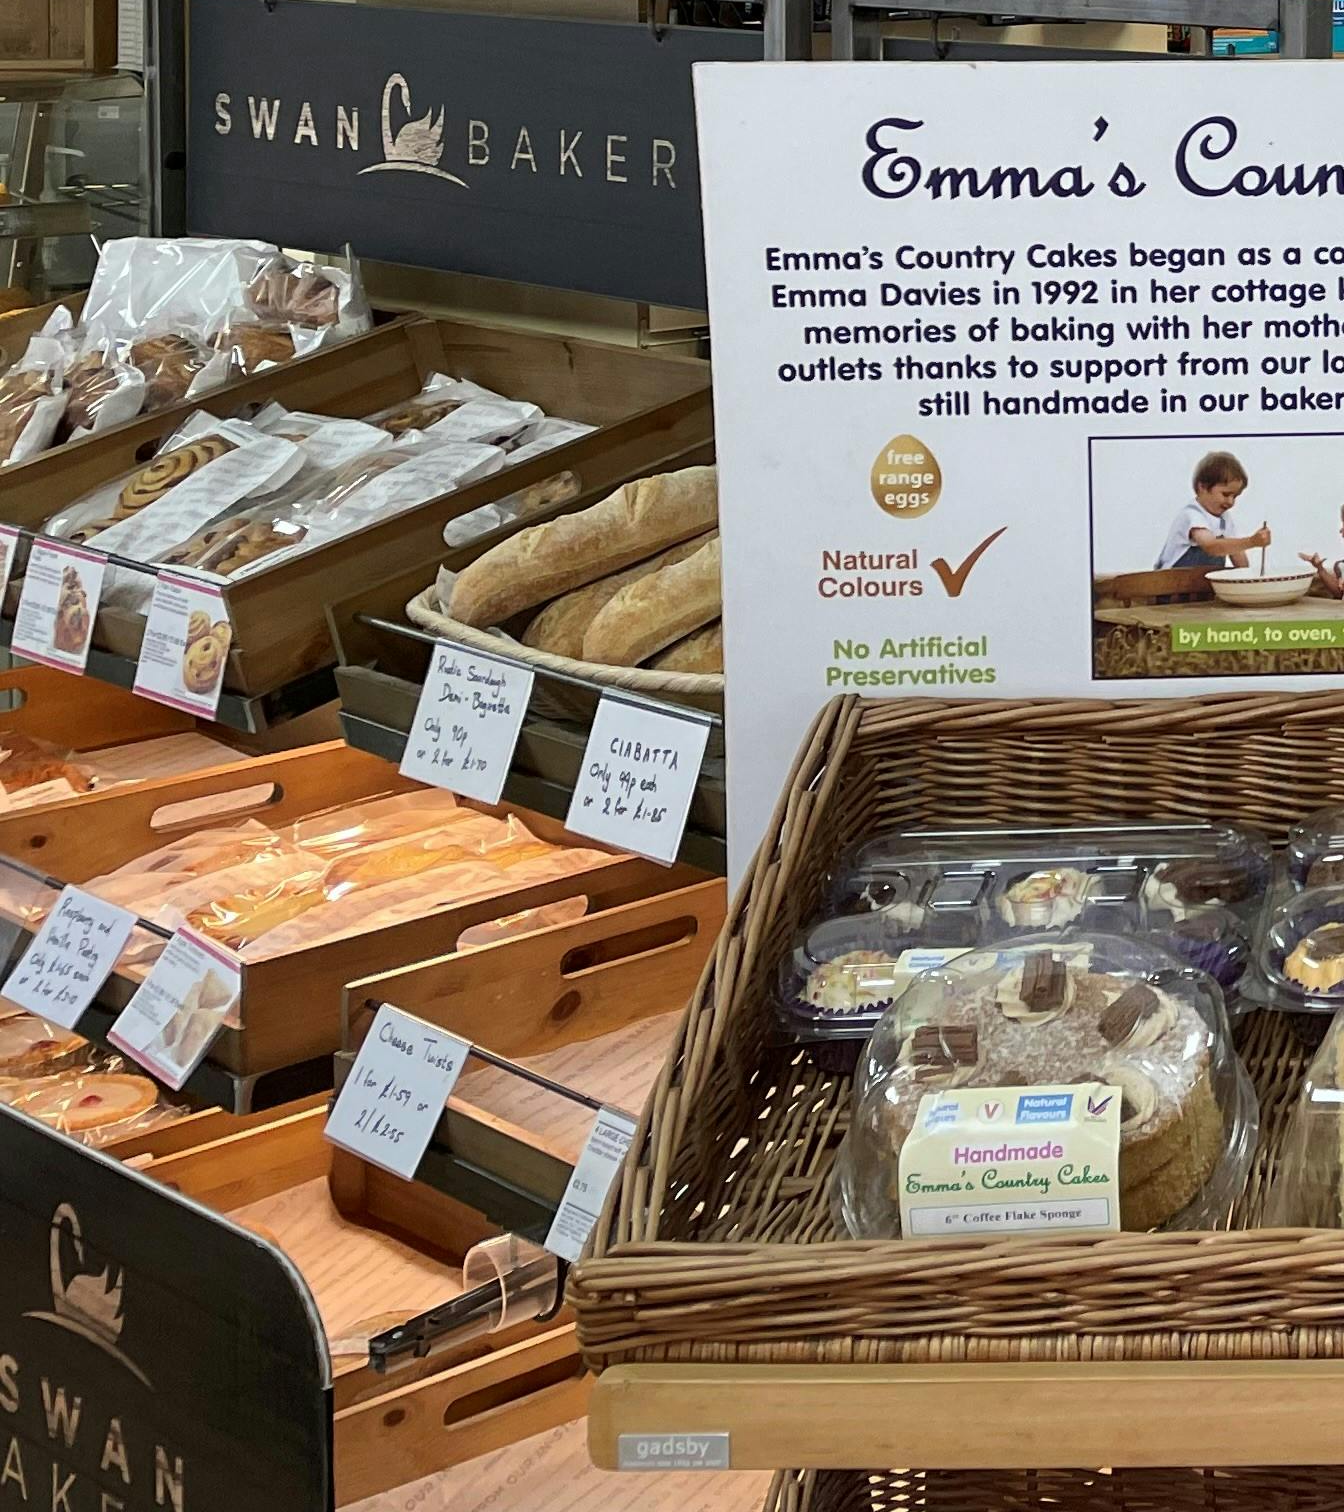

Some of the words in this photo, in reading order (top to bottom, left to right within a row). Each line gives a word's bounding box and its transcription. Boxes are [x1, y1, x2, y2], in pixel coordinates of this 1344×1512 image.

[214, 92, 360, 152] SWAN
[468, 119, 678, 190] BAKER
[861, 115, 1147, 200] Emma's
[765, 245, 884, 272] Emma's
[895, 244, 1016, 275] Country
[1026, 243, 1118, 269] Cakes
[1128, 242, 1226, 274] began
[1237, 247, 1272, 267] as
[1282, 245, 1302, 266] a
[770, 284, 867, 308] Emma
[880, 281, 982, 307] Davies
[992, 280, 1020, 305] in
[1031, 280, 1099, 305] 1992
[1110, 279, 1138, 305] in
[1149, 279, 1202, 304] her
[1211, 277, 1327, 308] cottage
[803, 318, 957, 345] memories
[967, 316, 1000, 343] of
[1010, 316, 1115, 347] baking
[1126, 314, 1191, 341] with
[1202, 314, 1253, 340] her
[777, 355, 884, 383] outlets
[893, 354, 997, 381] thanks
[1008, 354, 1039, 380] to
[1049, 353, 1167, 384] support
[1176, 350, 1249, 377] from
[1260, 355, 1312, 376] our
[918, 390, 970, 417] still
[982, 389, 1149, 416] handmade
[1160, 388, 1188, 413] in
[1198, 392, 1250, 413] our
[886, 448, 925, 467] free
[878, 469, 935, 490] range
[883, 491, 930, 509] eggs
[821, 548, 919, 571] Natural
[817, 575, 924, 599] Colours
[832, 639, 871, 660] No
[878, 635, 988, 659] Artificial
[1178, 627, 1202, 648] by
[1206, 626, 1259, 647] hand,
[1264, 625, 1283, 642] to
[1288, 626, 1336, 644] oven,
[825, 663, 997, 687] Preservatives
[609, 737, 680, 771] CIABATTA
[378, 1021, 415, 1057] Cheese
[422, 1037, 454, 1072] Twists
[953, 1141, 1065, 1165] Handmade
[904, 1171, 976, 1196] Emma's
[980, 1167, 1052, 1195] Country
[1057, 1162, 1111, 1187] Cakes
[962, 1209, 1002, 1224] Coffee
[1004, 1208, 1037, 1222] Flake
[1040, 1207, 1083, 1223] Sponge
[636, 1437, 711, 1460] gadsby
